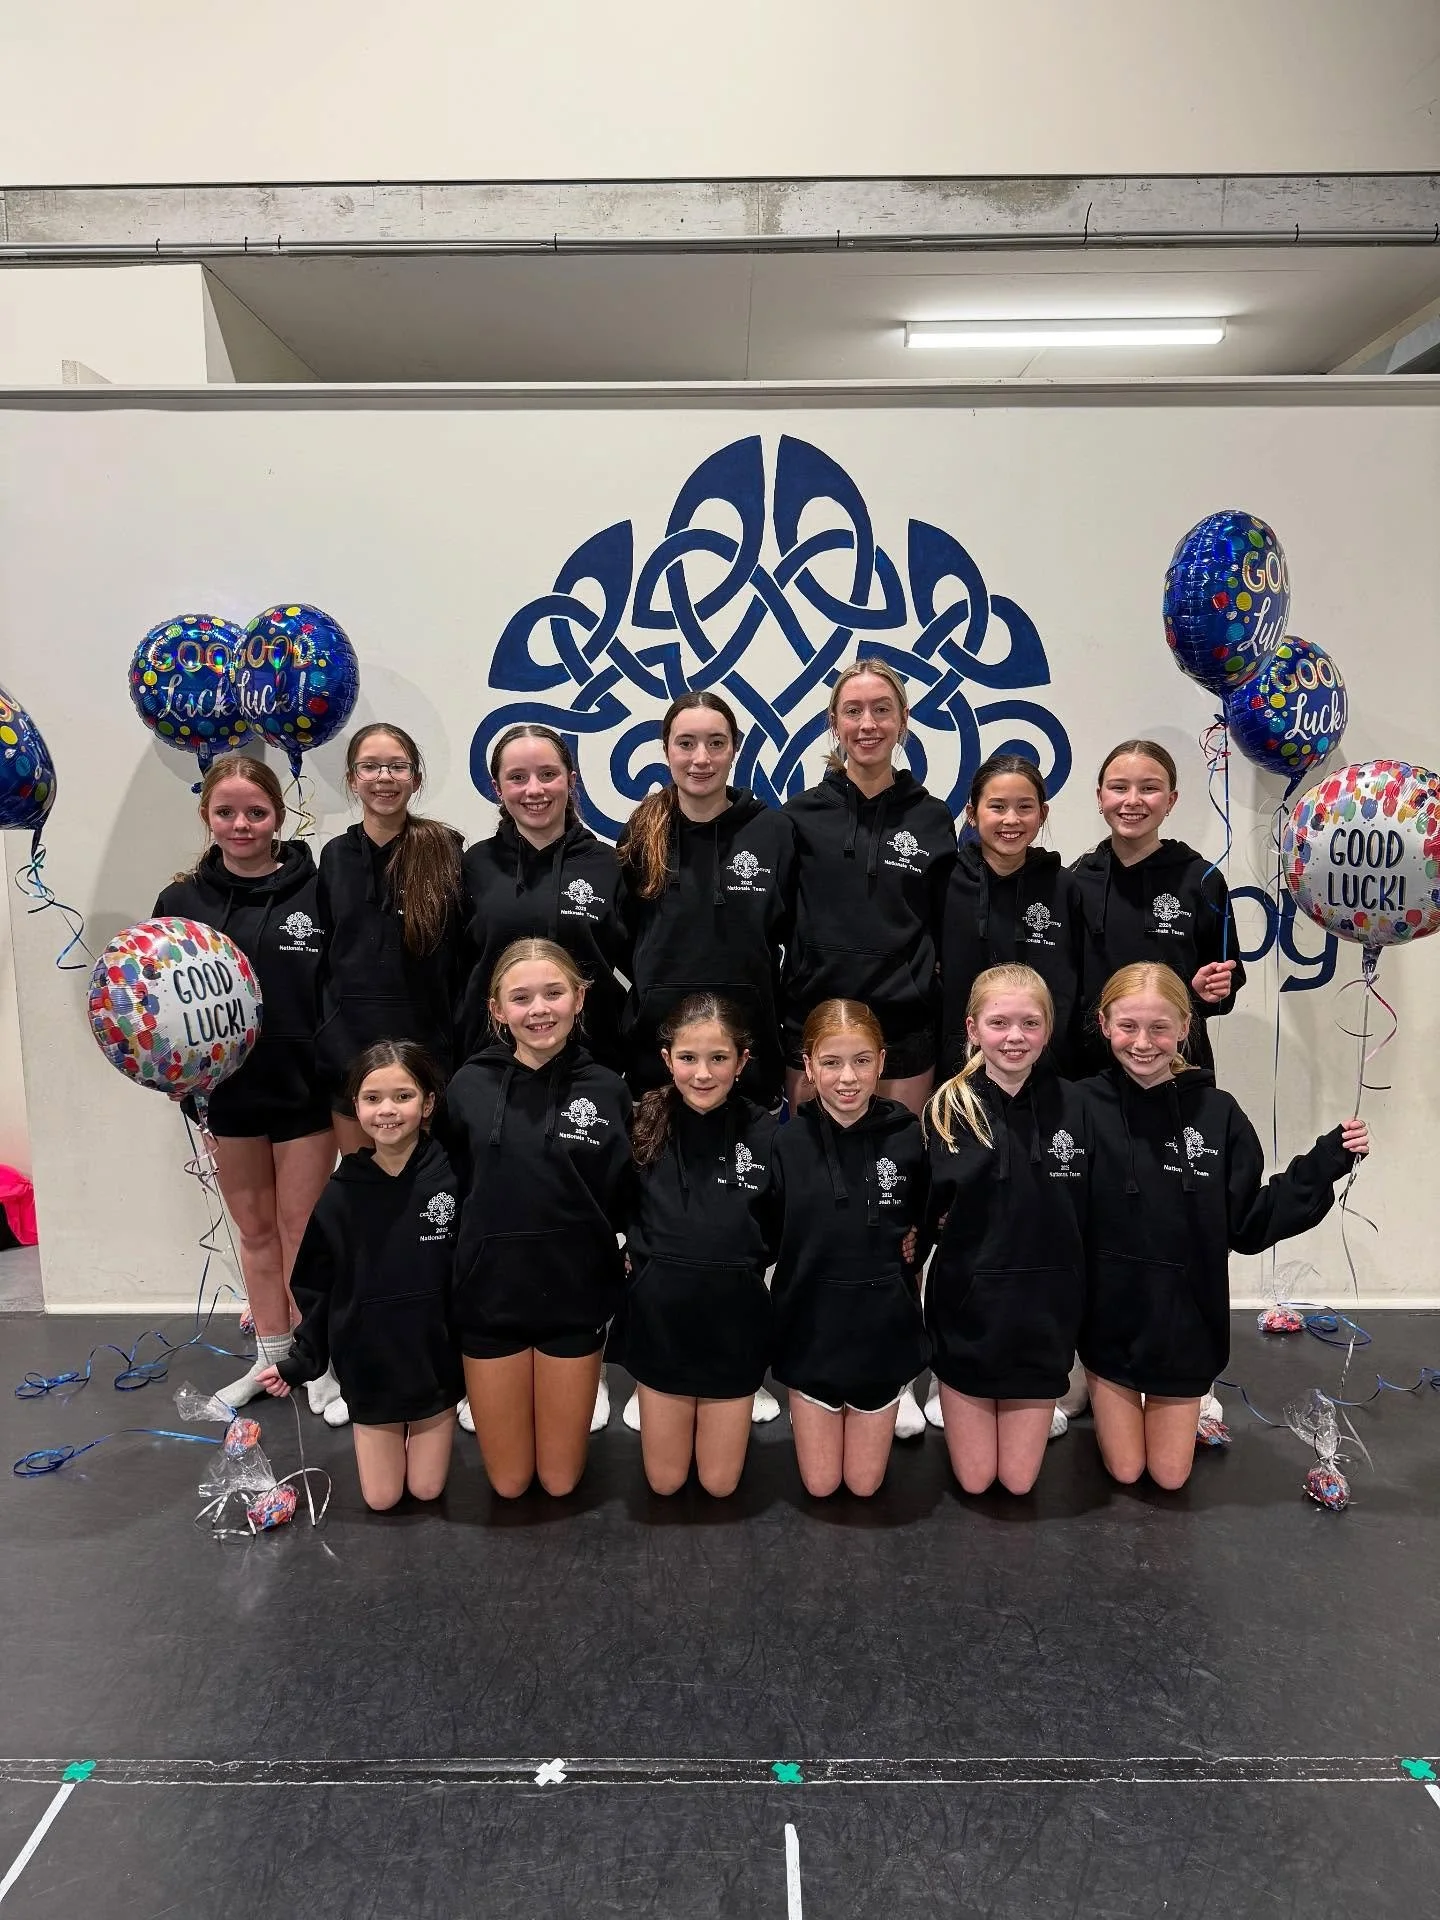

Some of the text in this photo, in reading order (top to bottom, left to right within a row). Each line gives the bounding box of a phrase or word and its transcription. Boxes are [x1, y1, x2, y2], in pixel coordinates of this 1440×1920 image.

[148, 635, 232, 673] GOO
[1284, 690, 1348, 741] Luck!
[1329, 827, 1405, 869] GOOD
[909, 864, 922, 873] Team
[1327, 871, 1406, 912] LUCK!
[173, 960, 233, 1004] GOOD
[183, 998, 246, 1046] LUCK!
[586, 1136, 600, 1146] Team
[743, 1182, 759, 1191] Team
[1193, 1169, 1210, 1177] Team
